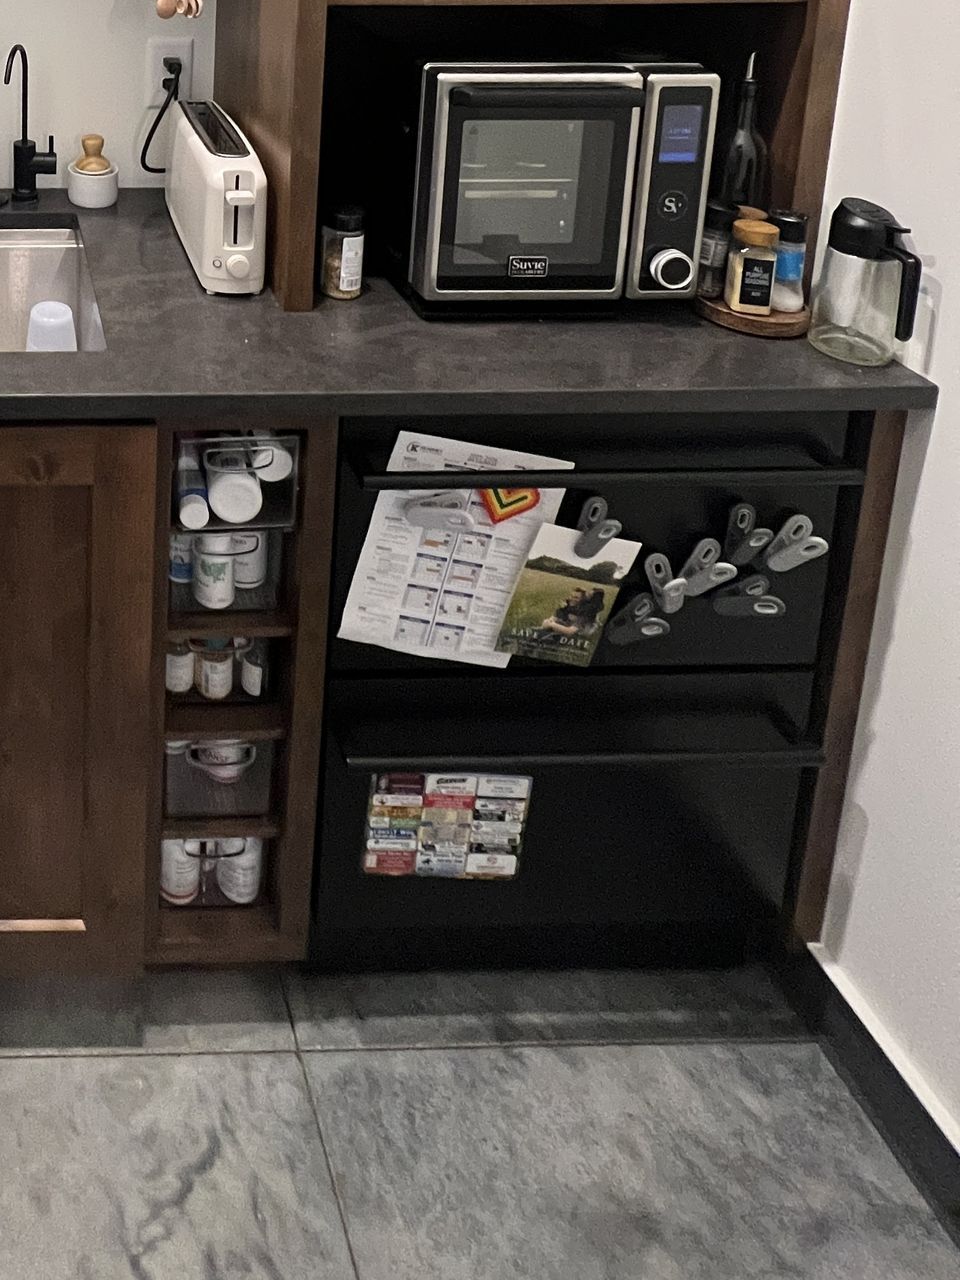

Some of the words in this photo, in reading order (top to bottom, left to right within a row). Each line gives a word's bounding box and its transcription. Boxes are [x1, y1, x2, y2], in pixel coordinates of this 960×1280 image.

[512, 259, 545, 269] Suvie
[511, 627, 538, 639] SAVE
[559, 636, 591, 648] DATE
